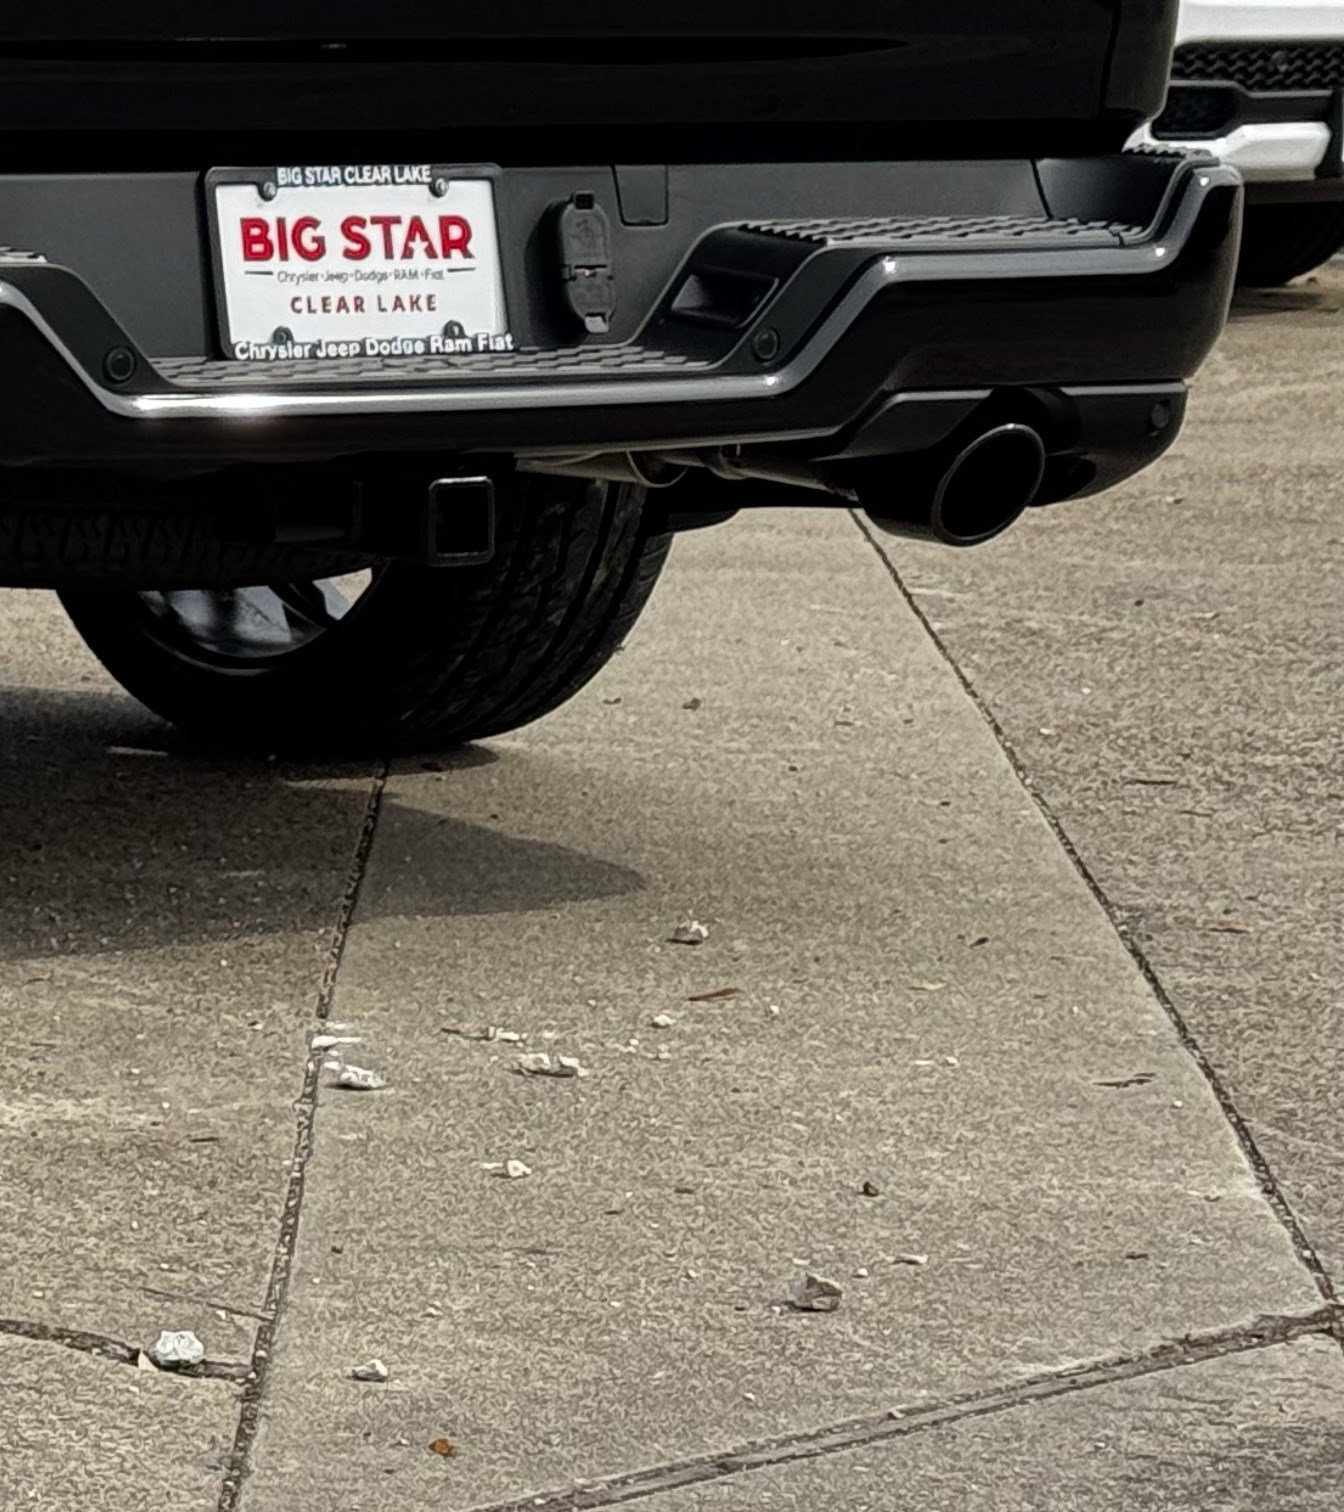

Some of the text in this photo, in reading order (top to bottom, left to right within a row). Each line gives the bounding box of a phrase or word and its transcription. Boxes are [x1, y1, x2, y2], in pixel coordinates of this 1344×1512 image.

[277, 165, 432, 186] BIG STAR CLEAR LAKE
[240, 214, 475, 262] BIG STAR
[290, 293, 437, 315] CLEAR LAKE
[234, 333, 514, 360] Chrysler Jeep Dodge Ram Fiat
